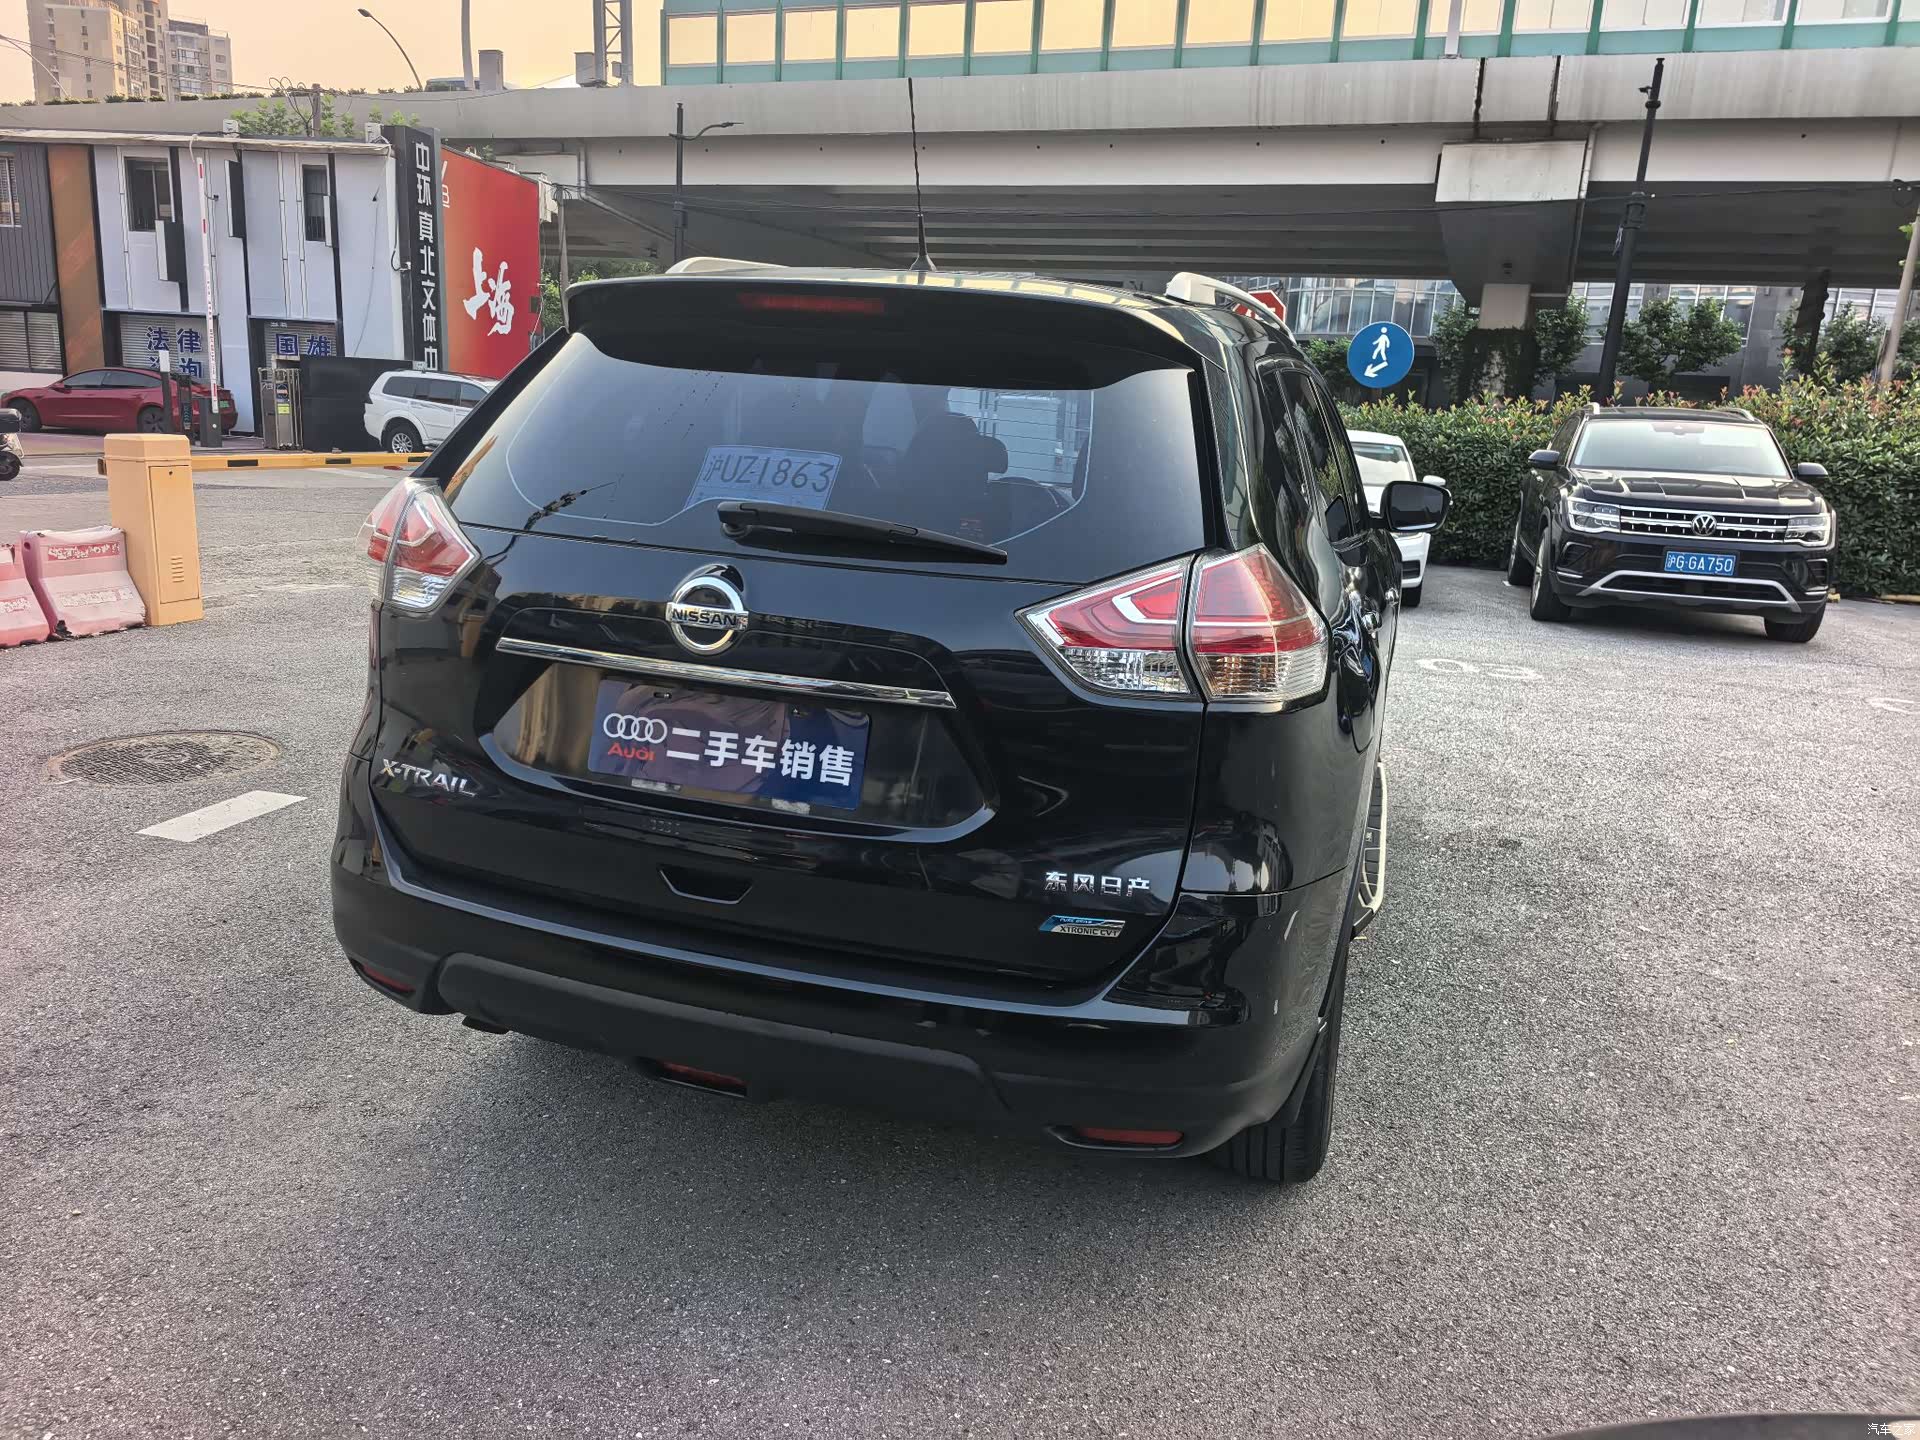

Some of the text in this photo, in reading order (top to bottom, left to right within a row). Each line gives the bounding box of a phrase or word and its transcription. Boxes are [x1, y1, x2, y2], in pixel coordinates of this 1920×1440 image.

[463, 247, 514, 336] 上海
[146, 327, 202, 353] 法律
[672, 608, 737, 626] NISSAN
[608, 741, 656, 762] Audi
[666, 727, 855, 787] 二手车销售
[380, 759, 477, 798] X-TRAIL
[1044, 871, 1150, 897] 东风日产
[1060, 925, 1118, 937] XTRONIC CVT
